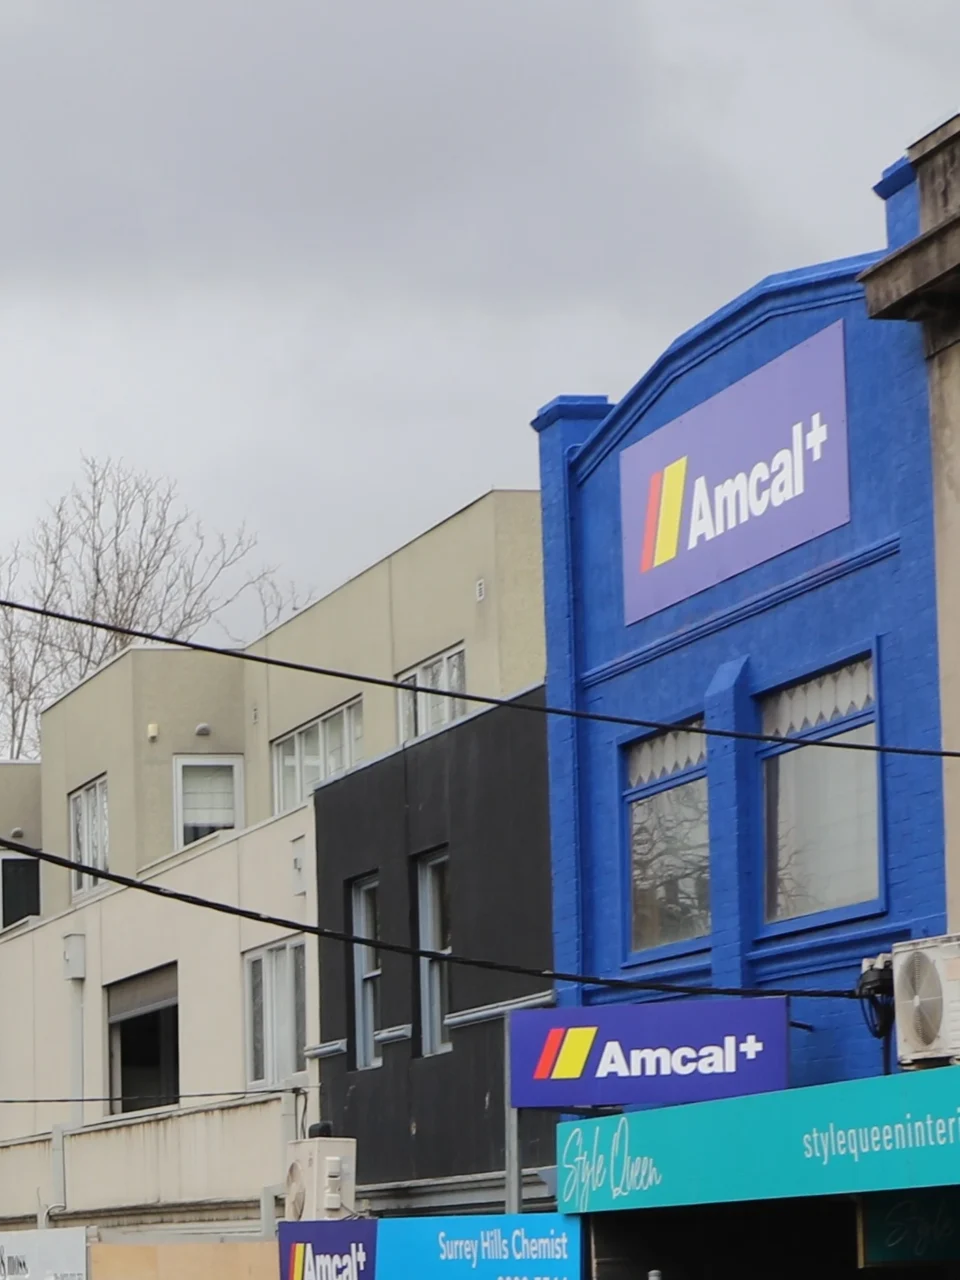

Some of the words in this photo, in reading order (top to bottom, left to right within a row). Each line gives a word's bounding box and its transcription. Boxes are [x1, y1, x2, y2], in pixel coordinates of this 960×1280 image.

[562, 1126, 607, 1212] Style
[610, 1117, 662, 1199] Queen
[438, 1231, 478, 1268] Surrey
[480, 1228, 509, 1259] Hills
[511, 1228, 568, 1260] Chemist
